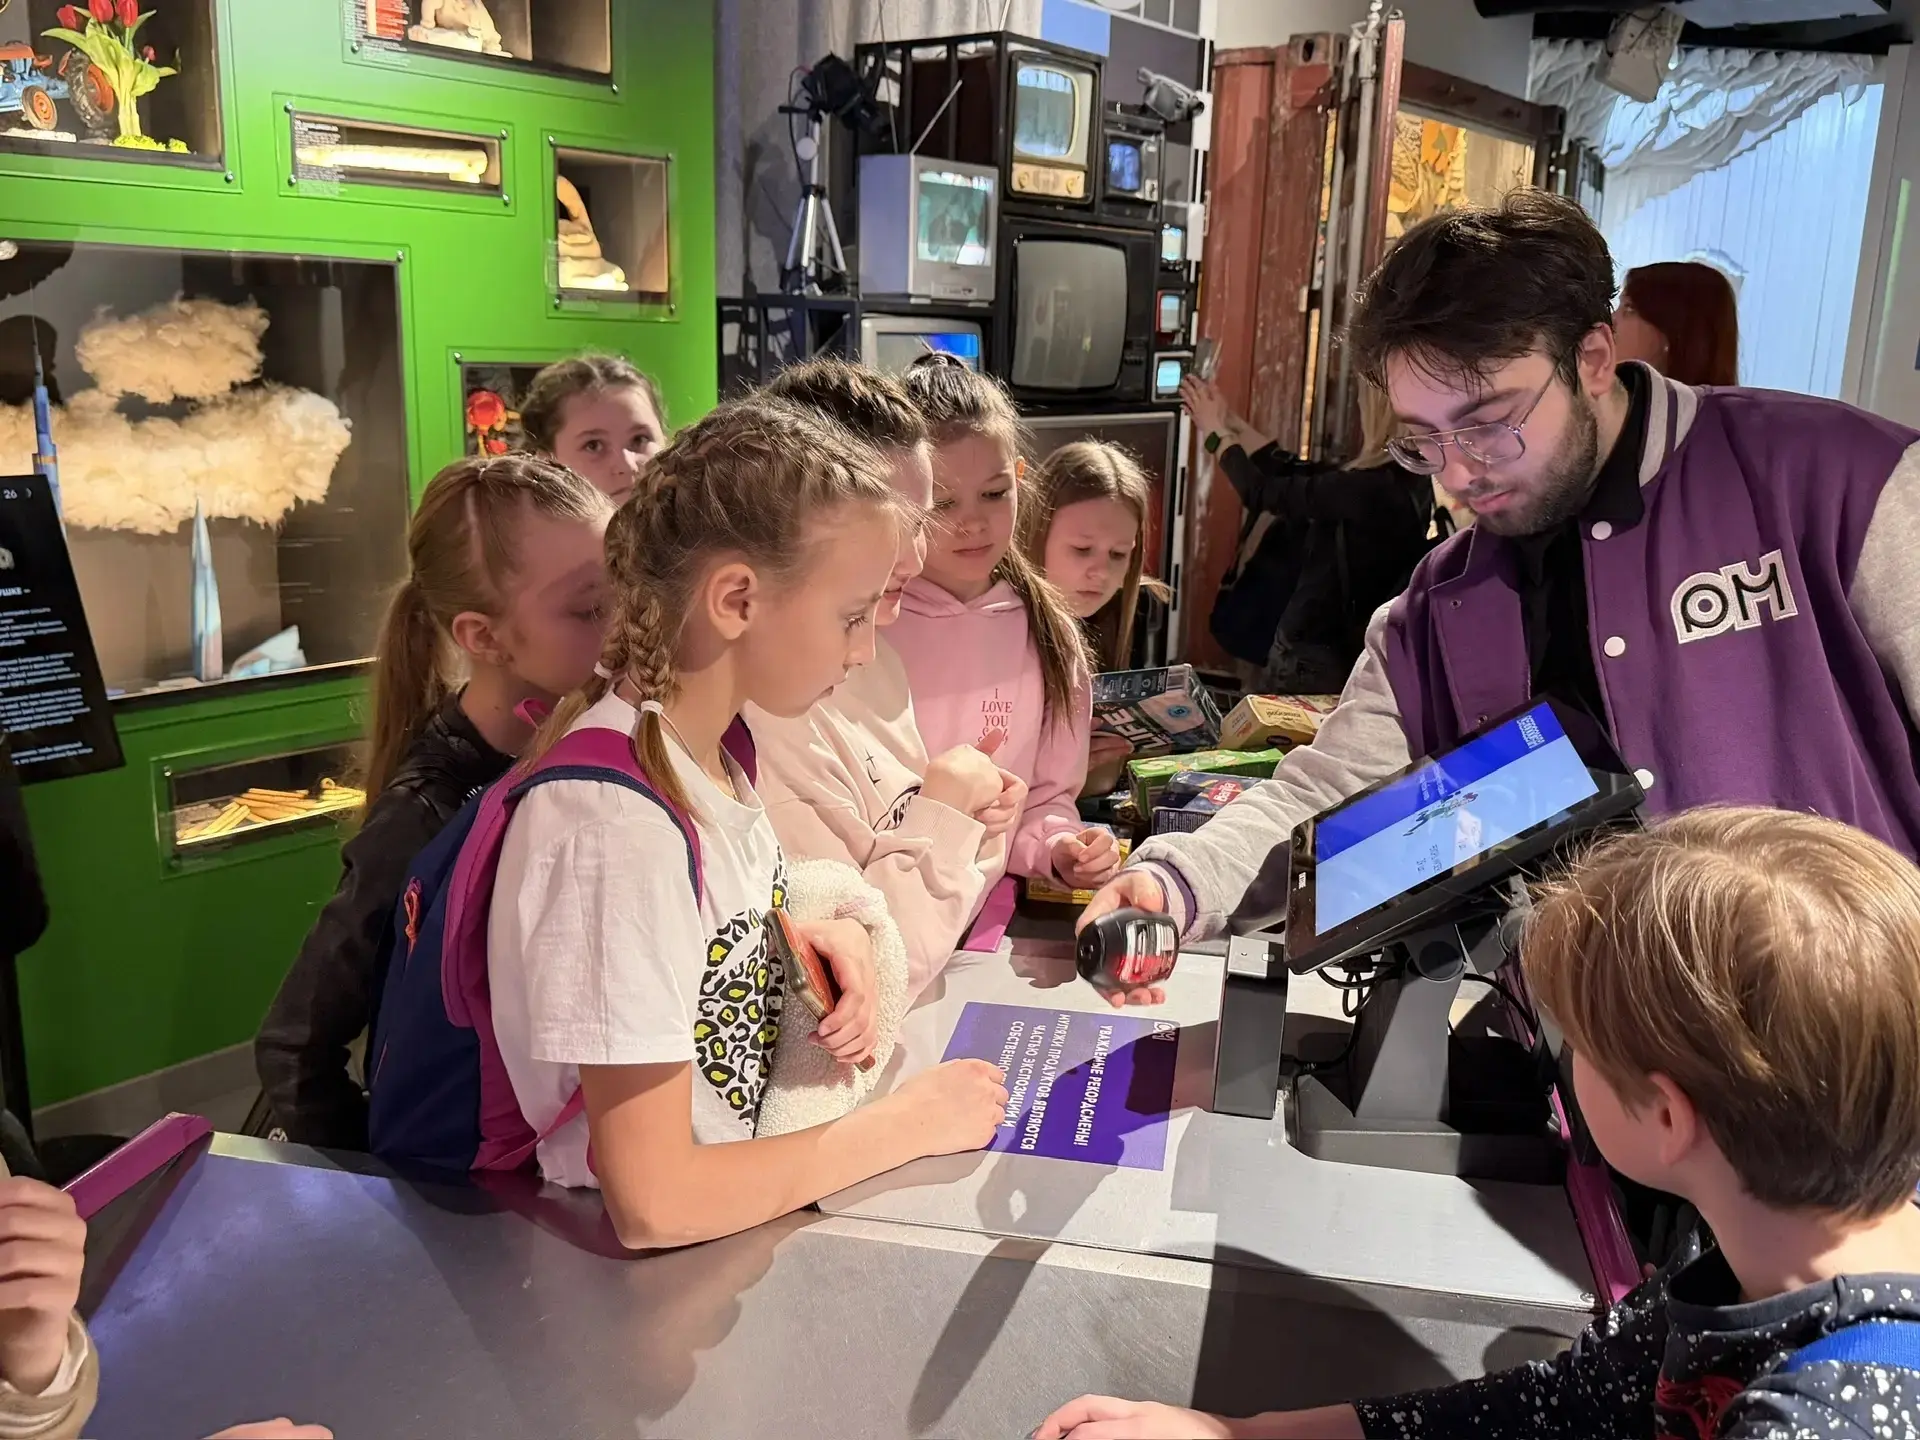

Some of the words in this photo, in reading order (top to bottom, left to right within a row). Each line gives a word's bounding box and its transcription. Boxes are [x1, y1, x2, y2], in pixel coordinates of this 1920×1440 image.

[981, 700, 1013, 714] LOVE
[994, 687, 999, 700] I
[984, 714, 1009, 728] YOU
[1101, 708, 1168, 749] LIFE
[1025, 1024, 1047, 1056] ЧАСТЬЮ
[1050, 1013, 1071, 1048] МУЛЯЖИ
[1090, 1025, 1113, 1075] УВАЖАЕМЫЕ
[1004, 1057, 1036, 1118] ЭКСПОЗИЦИИ
[1035, 1048, 1062, 1098] ПРОДУКТОВ
[1001, 1119, 1017, 1128] И
[1020, 1099, 1048, 1150] ЯВЛЯЮТСЯ
[1073, 1076, 1103, 1147] РЕКОРДСМЕНЫ!
